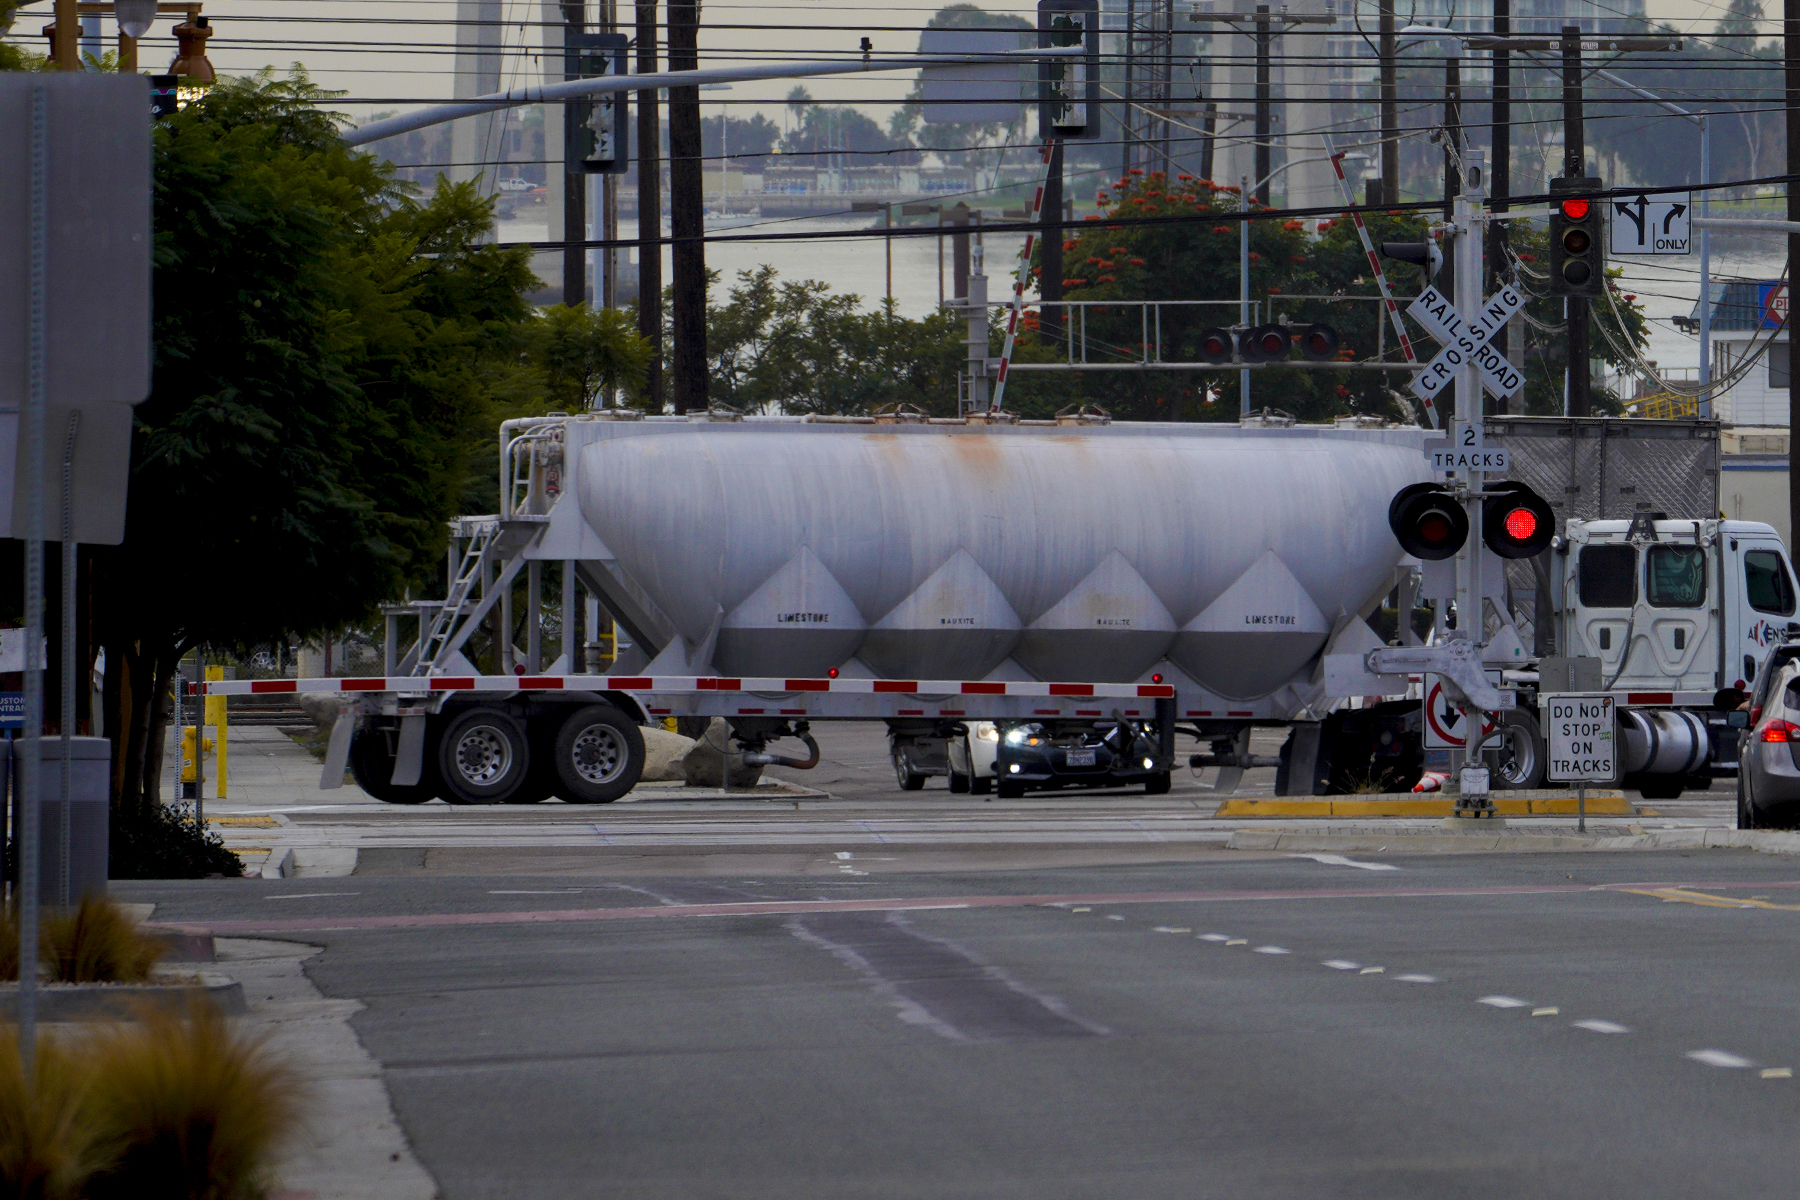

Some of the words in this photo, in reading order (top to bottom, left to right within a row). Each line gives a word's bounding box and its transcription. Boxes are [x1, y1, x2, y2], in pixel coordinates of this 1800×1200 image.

[1656, 239, 1688, 250] ONLY
[1421, 291, 1518, 390] CROSSING
[1464, 429, 1476, 446] 2
[1435, 453, 1504, 466] TRACKS
[778, 613, 829, 623] LIMESTONE
[1245, 615, 1296, 625] LIMESTONE
[1553, 706, 1573, 719] DO
[1579, 705, 1609, 719] NOT
[1562, 723, 1601, 737] STOP
[1571, 742, 1593, 754] ON
[1553, 759, 1611, 773] TRACKS
